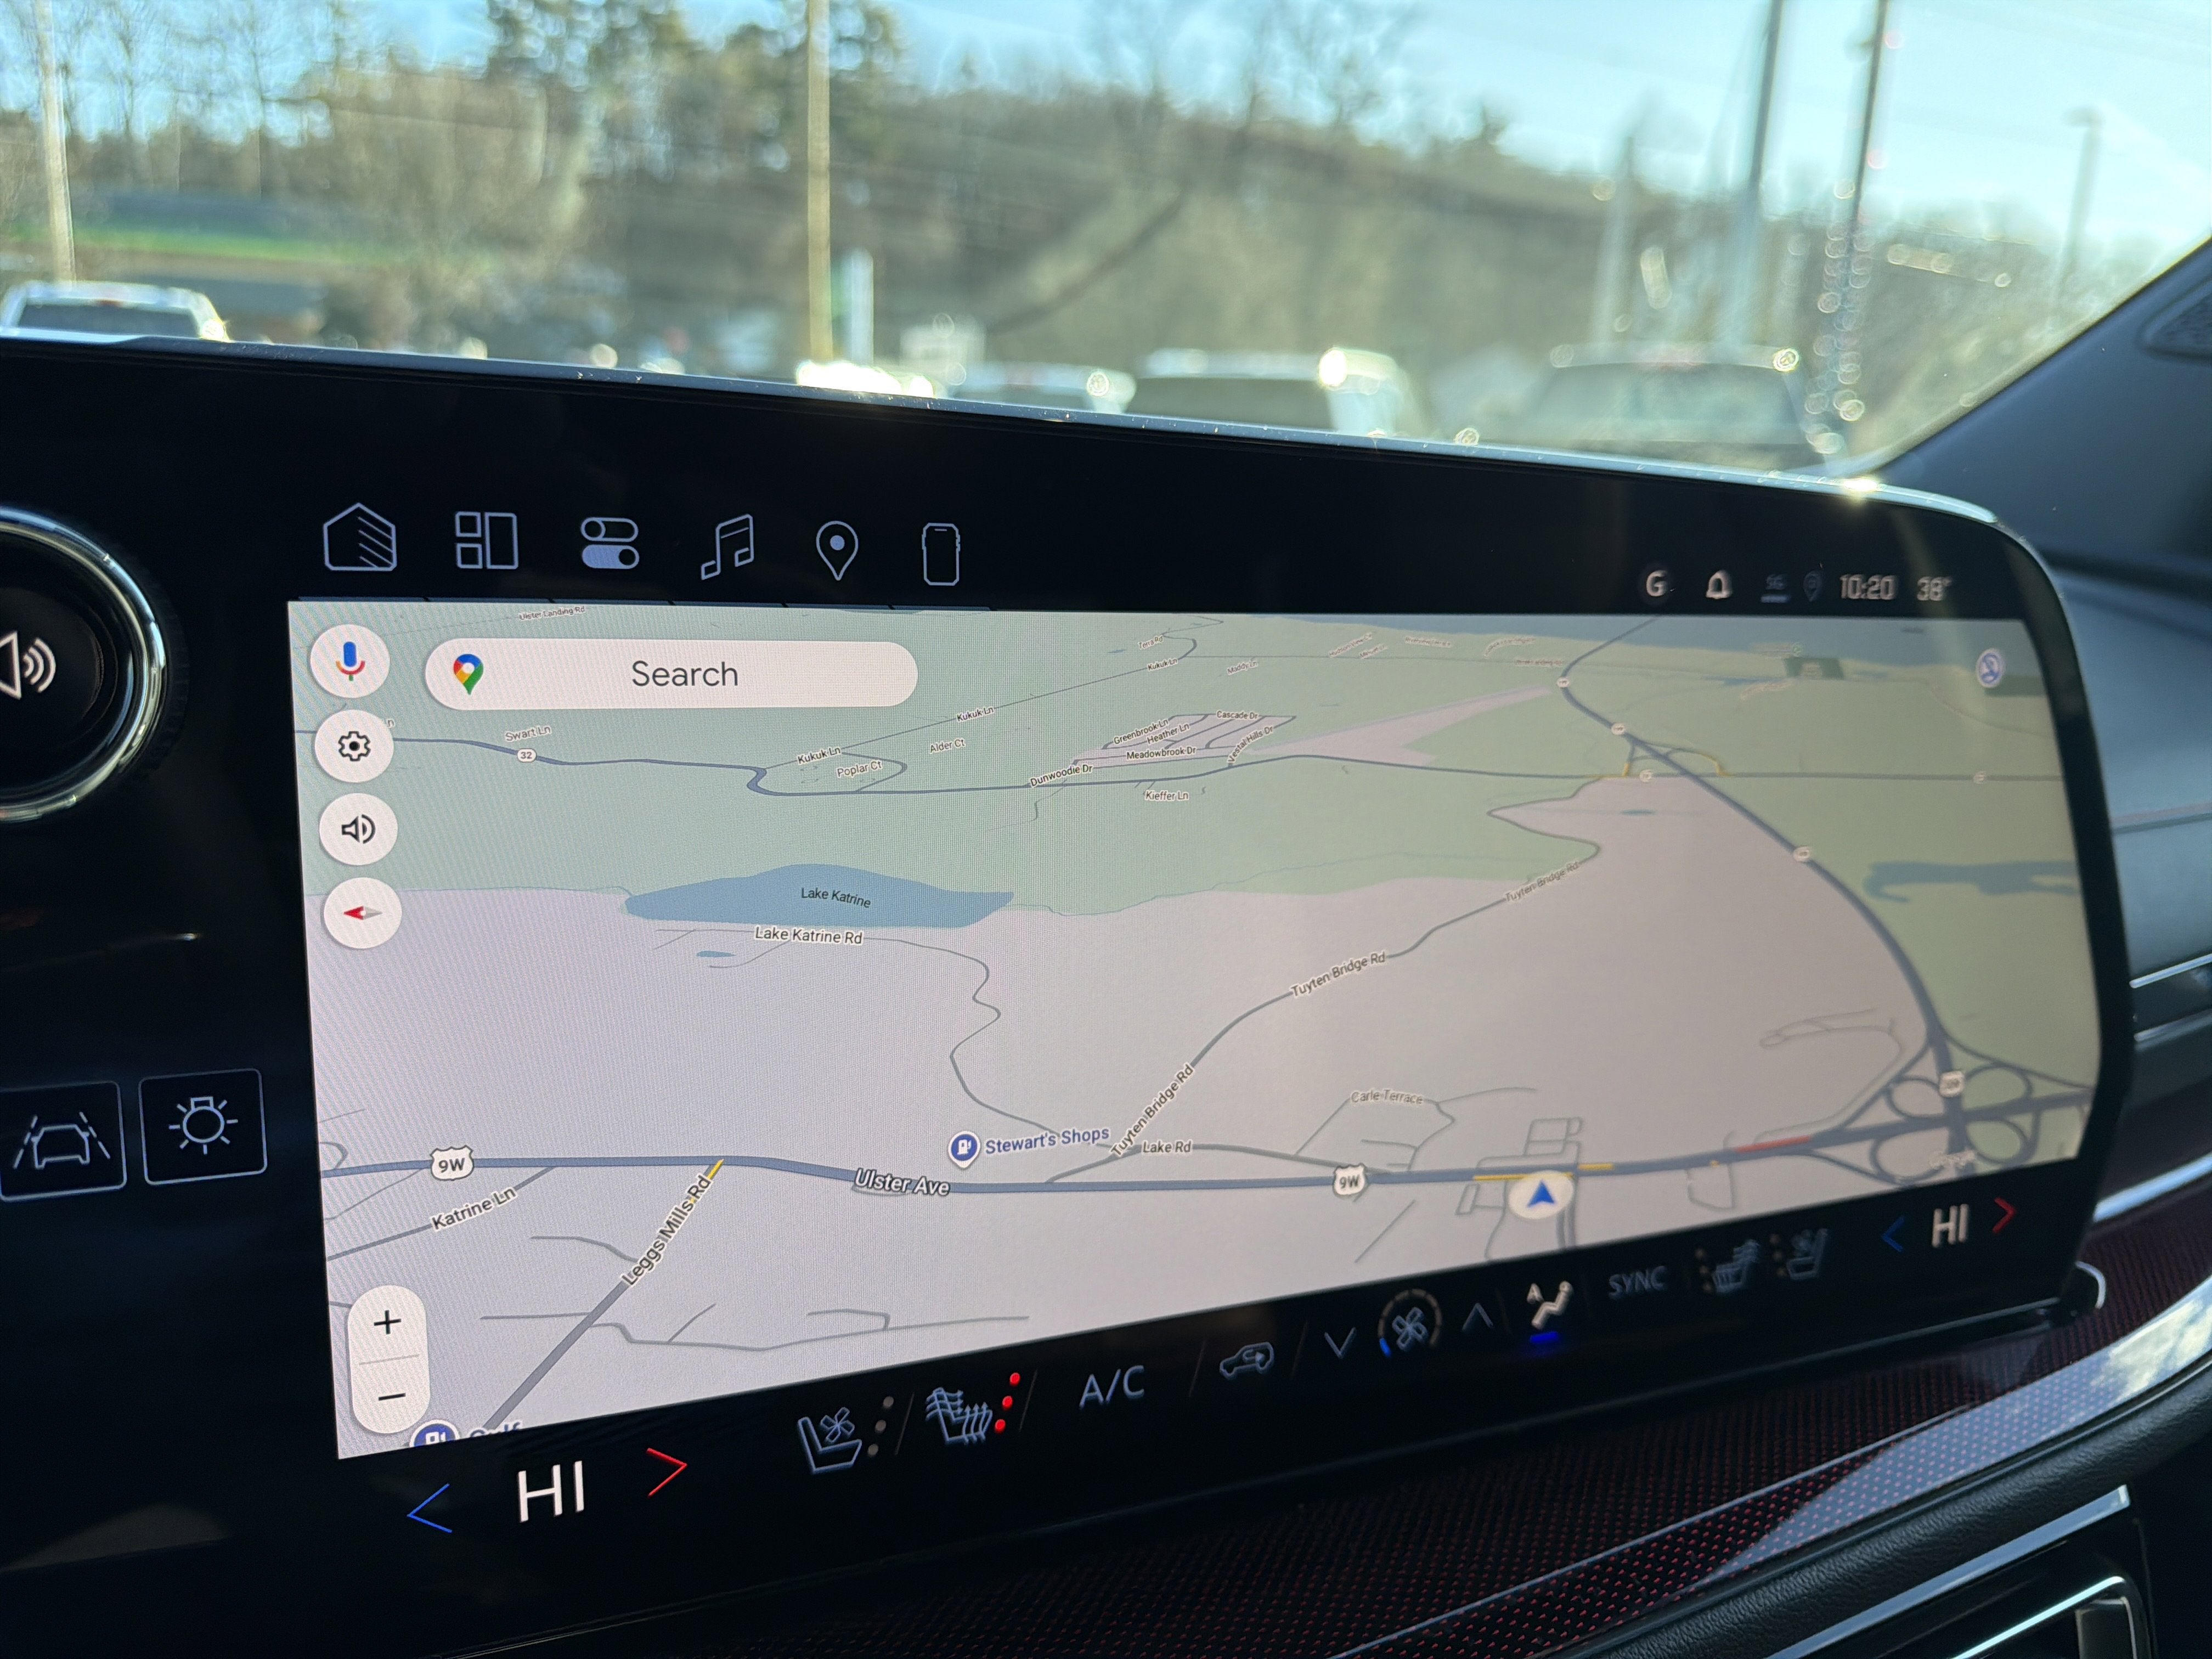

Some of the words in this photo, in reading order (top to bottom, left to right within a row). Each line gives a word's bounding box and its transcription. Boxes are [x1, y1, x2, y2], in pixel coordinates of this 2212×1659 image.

[1840, 574, 1898, 600] 10:20
[543, 607, 574, 617] Landing
[631, 659, 738, 687] Search
[1147, 661, 1169, 671] Kukuk
[956, 709, 983, 721] Kukuk
[983, 707, 994, 715] Ln
[1216, 711, 1249, 719] Cascade
[506, 728, 537, 741] Swart
[537, 725, 551, 735] Ln
[1114, 723, 1158, 744] Greenbrook
[1158, 719, 1169, 728] Ln
[1147, 729, 1179, 744] Heather
[1179, 723, 1190, 732] Ln
[930, 742, 953, 753] Alder
[954, 738, 966, 748] Ct
[1127, 747, 1184, 759] Meadowbrook
[1228, 739, 1248, 763] Vestal
[1247, 730, 1263, 743] Hills
[1264, 726, 1273, 734] Dr
[797, 751, 829, 764] Kukuk
[829, 747, 842, 757] Ln
[837, 764, 869, 777] Poplar
[870, 760, 882, 770] Ct
[1030, 766, 1081, 787] Dunwoodie
[1082, 764, 1093, 773] Dr
[1145, 791, 1175, 800] Kieffer
[1178, 792, 1188, 800] Ln
[1566, 861, 1579, 873] Rd
[800, 887, 829, 899] Lake
[831, 889, 871, 909] Katrine
[755, 927, 789, 940] Lake
[792, 928, 842, 943] Katrine
[844, 932, 862, 944] Rd
[1290, 970, 1331, 997] Tuyten
[1331, 957, 1369, 981] Bridge
[1370, 951, 1386, 966] Rd
[1350, 1090, 1380, 1103] Carle
[1383, 1090, 1424, 1105] Terrace
[1110, 1116, 1148, 1157] Tuyten
[1144, 1080, 1180, 1120] Bridge
[1176, 1064, 1194, 1085] Rd
[985, 1132, 1057, 1154] Stewart's
[1061, 1127, 1110, 1146] Shops
[1142, 1139, 1173, 1154] Lake
[1176, 1139, 1192, 1153] Rd
[438, 1158, 466, 1172] 9W
[854, 1169, 909, 1193] Ulster
[912, 1177, 950, 1197] Ave
[1339, 1175, 1361, 1189] 9W
[432, 1198, 493, 1231] Katrine
[493, 1187, 516, 1205] Ln
[620, 1237, 666, 1286] Leggs
[659, 1198, 694, 1239] Mills
[687, 1175, 712, 1200] Rd
[1931, 1203, 1970, 1248] HI
[1609, 1265, 1668, 1300] SYNC
[1079, 1365, 1145, 1409] A/C
[518, 1460, 585, 1523] HI
